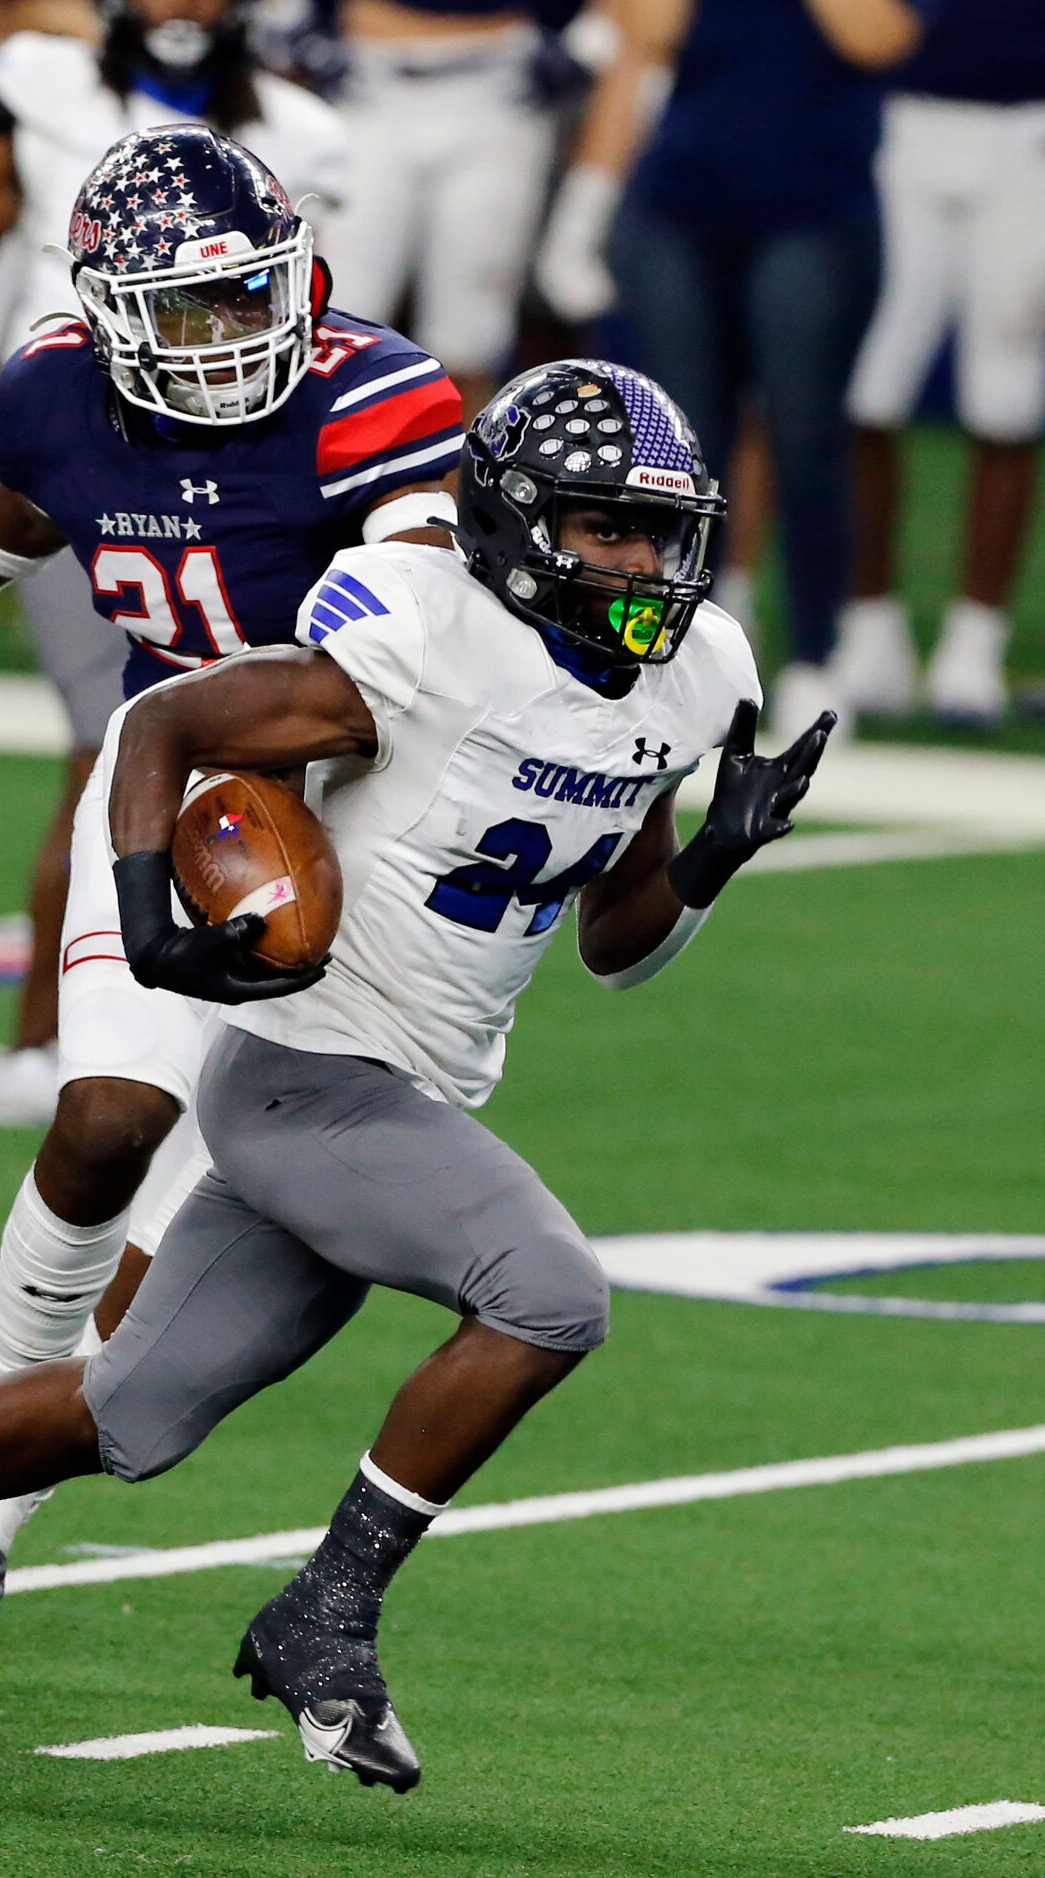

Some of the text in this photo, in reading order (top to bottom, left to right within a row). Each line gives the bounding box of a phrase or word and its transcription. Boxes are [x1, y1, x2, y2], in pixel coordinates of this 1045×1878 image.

[200, 241, 227, 258] UNE
[639, 472, 690, 489] Riddell
[115, 513, 181, 538] RYAN
[92, 544, 246, 662] 21
[512, 758, 657, 808] SUMMIT
[424, 817, 625, 936] 24
